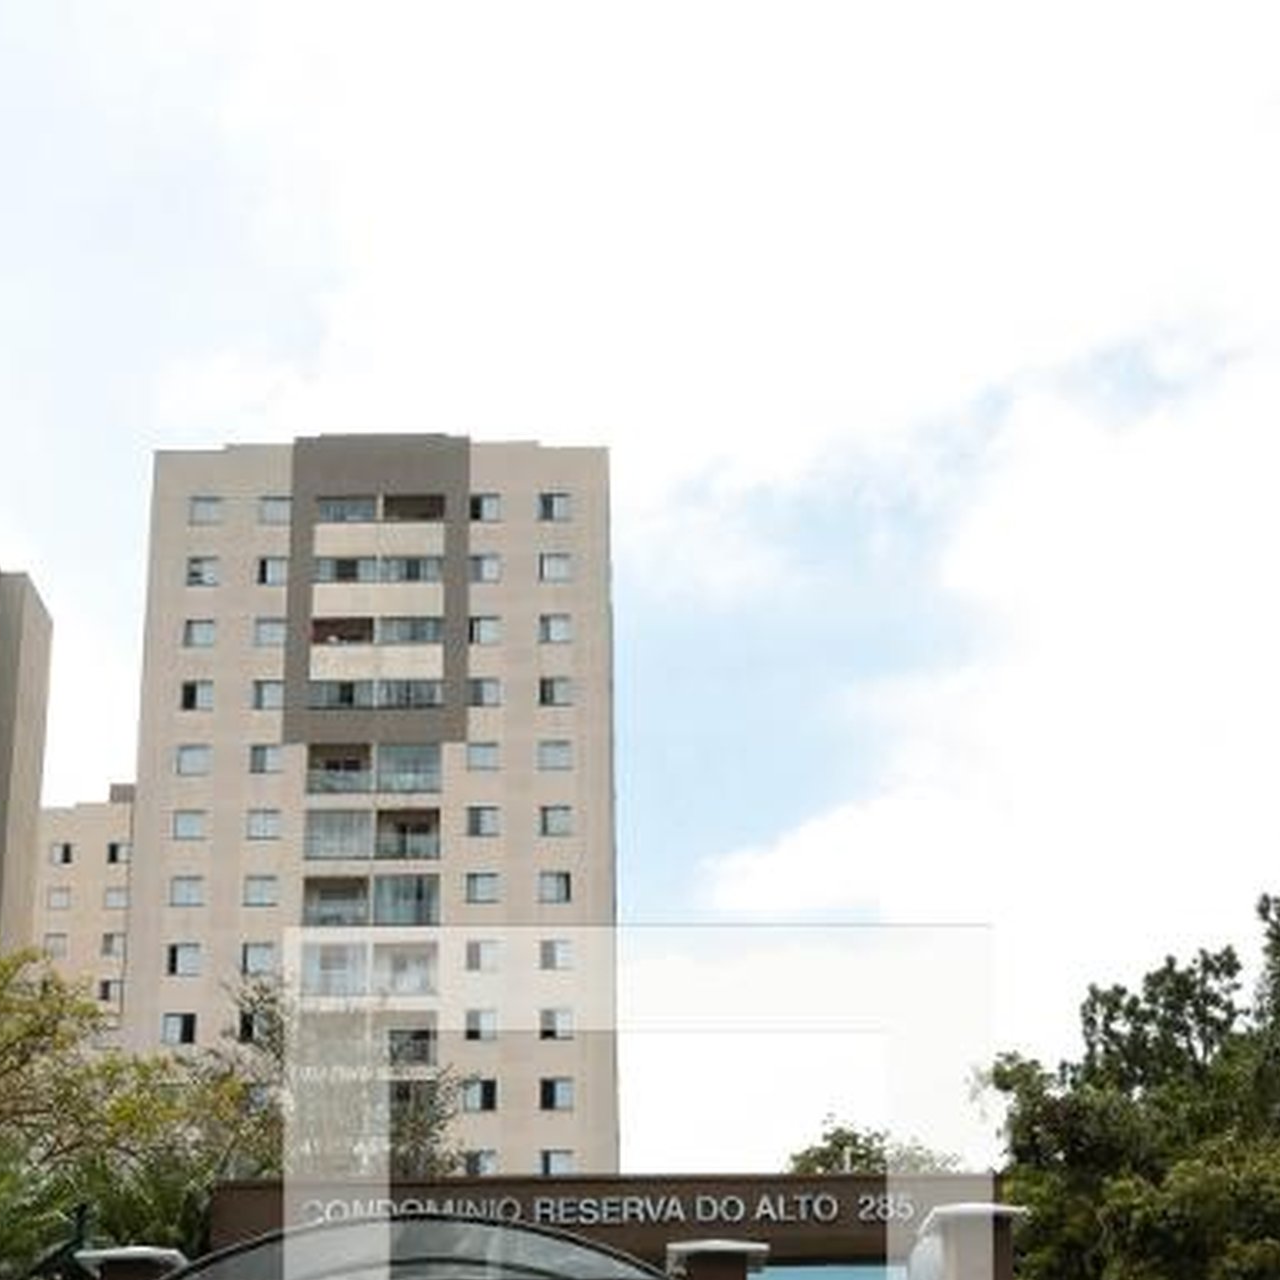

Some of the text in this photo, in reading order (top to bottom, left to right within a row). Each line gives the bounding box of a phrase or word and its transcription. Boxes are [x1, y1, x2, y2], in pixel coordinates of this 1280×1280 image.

[533, 1196, 685, 1224] RESERVA
[695, 1195, 746, 1222] DO
[754, 1194, 840, 1222] ALTO
[857, 1194, 915, 1222] 285
